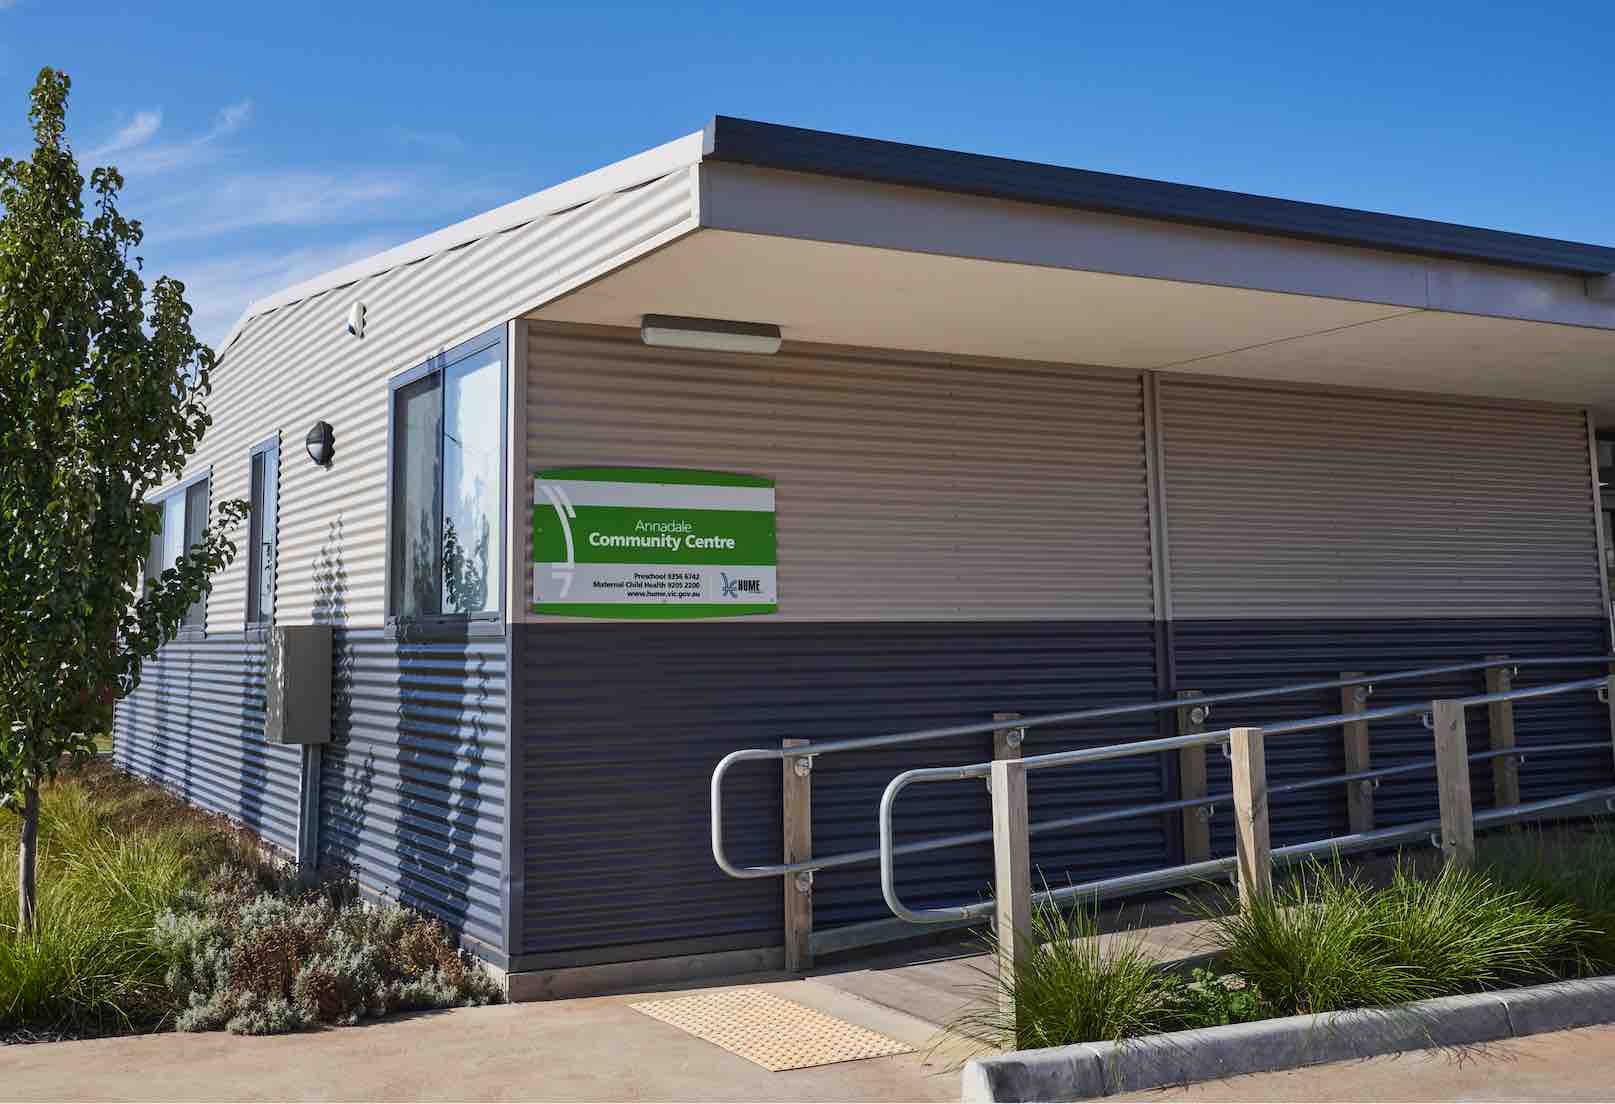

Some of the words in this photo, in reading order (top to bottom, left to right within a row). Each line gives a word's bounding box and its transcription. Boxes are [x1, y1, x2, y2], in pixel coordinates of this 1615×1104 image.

[634, 519, 693, 533] Annadale
[588, 532, 682, 552] Community
[685, 534, 736, 550] Centre
[633, 572, 666, 581] Preschool
[592, 580, 624, 589] Maternal
[625, 580, 643, 589] Child
[644, 580, 666, 589] Health
[737, 578, 761, 593] HUME
[626, 589, 701, 599] www.hume.vic.gov.au
